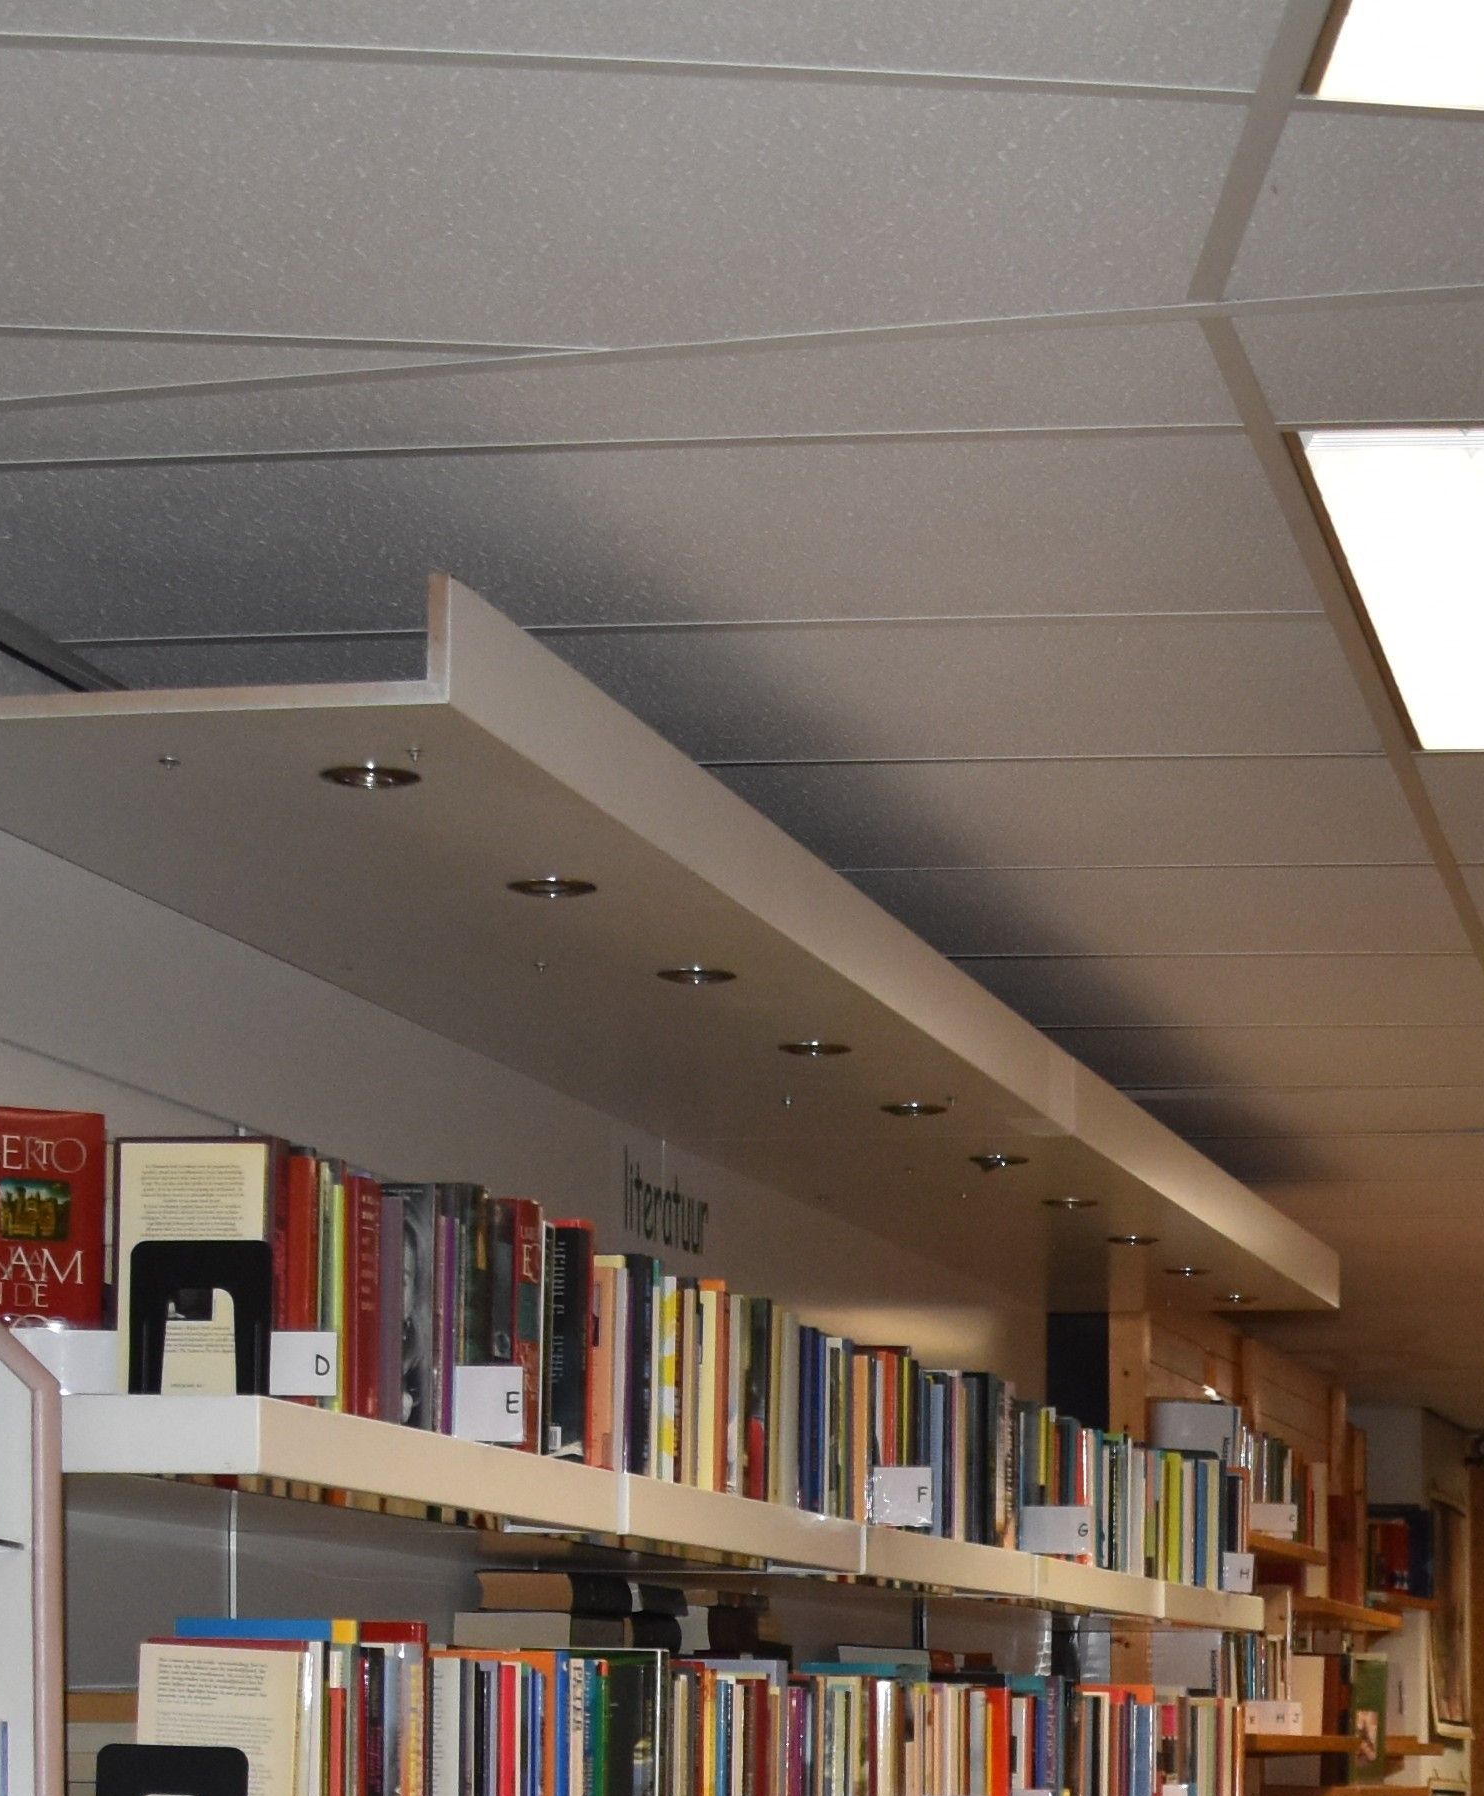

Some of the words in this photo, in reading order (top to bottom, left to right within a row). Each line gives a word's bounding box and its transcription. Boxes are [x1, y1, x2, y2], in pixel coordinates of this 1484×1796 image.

[624, 1146, 709, 1256] literatuur
[314, 1353, 331, 1376] D
[505, 1390, 521, 1414] E
[917, 1485, 930, 1503] F
[1077, 1521, 1090, 1539] G
